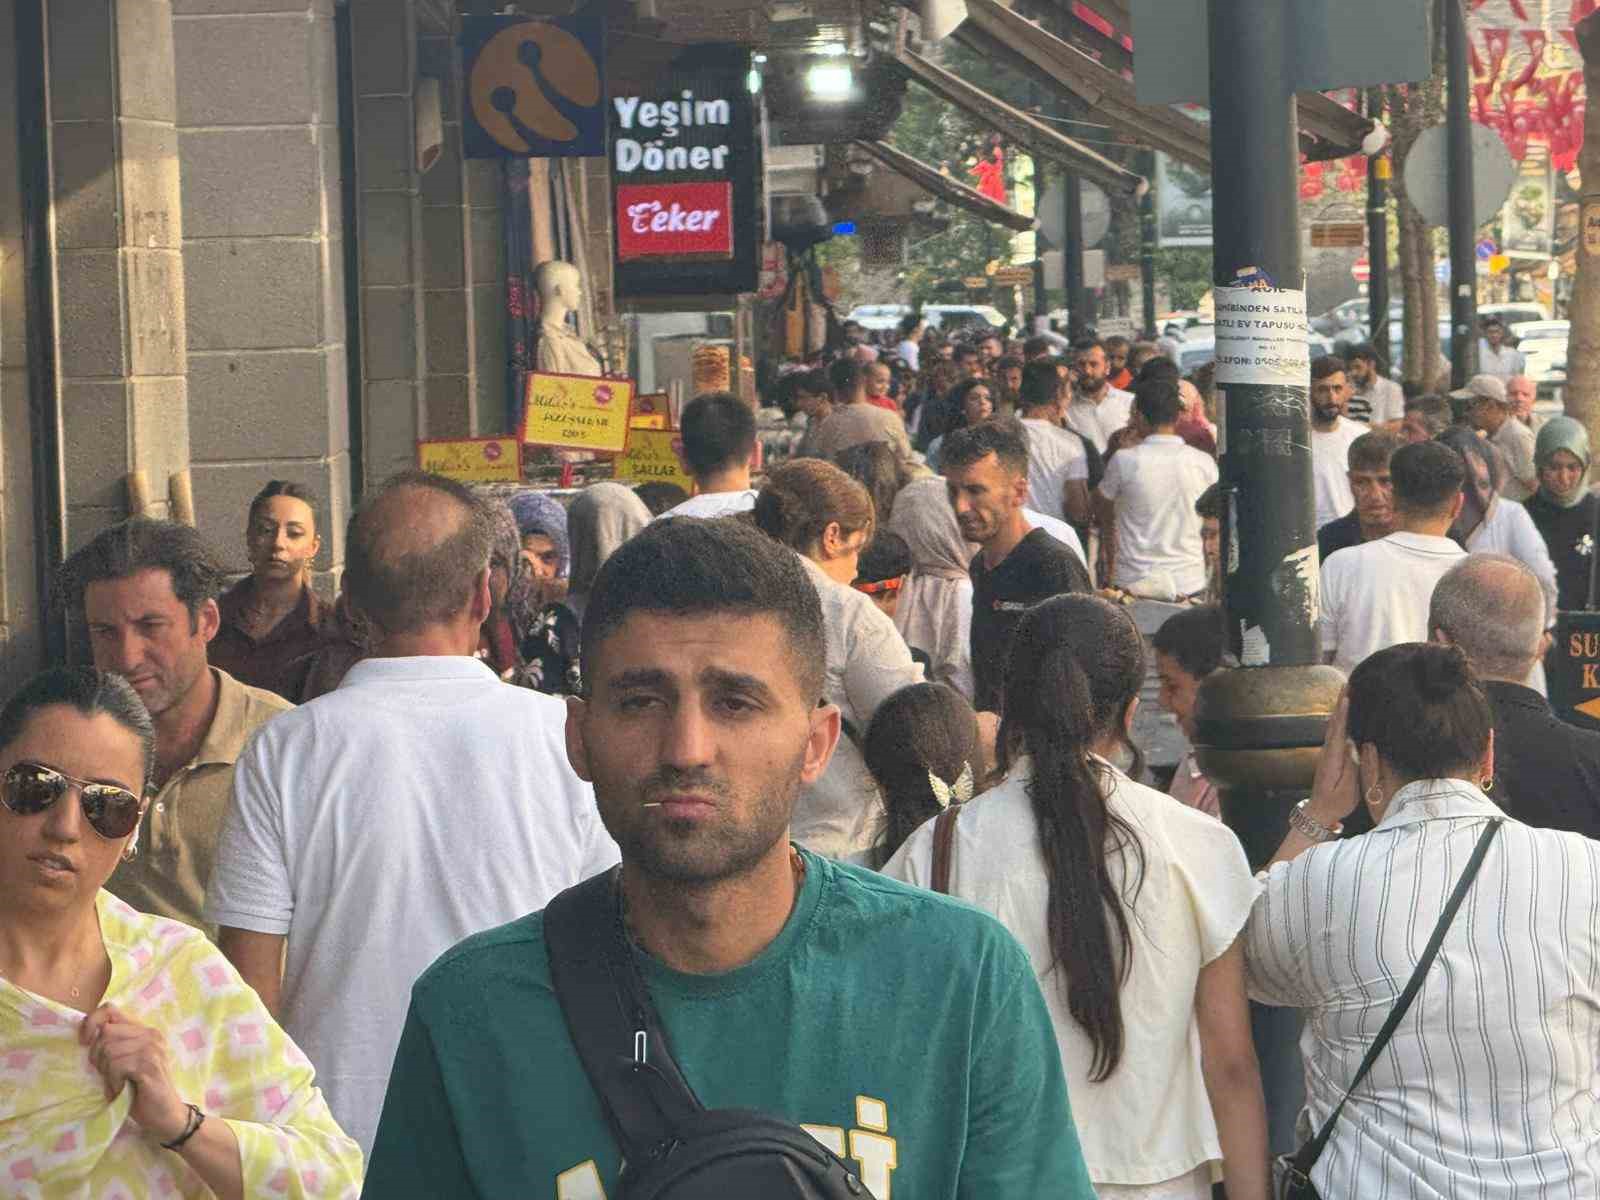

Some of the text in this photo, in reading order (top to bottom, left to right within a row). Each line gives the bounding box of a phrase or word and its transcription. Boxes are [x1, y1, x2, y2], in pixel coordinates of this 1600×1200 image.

[613, 89, 730, 137] Yeşim
[615, 138, 729, 172] Döner
[1237, 320, 1252, 329] EV
[1254, 320, 1295, 330] TAPUSU
